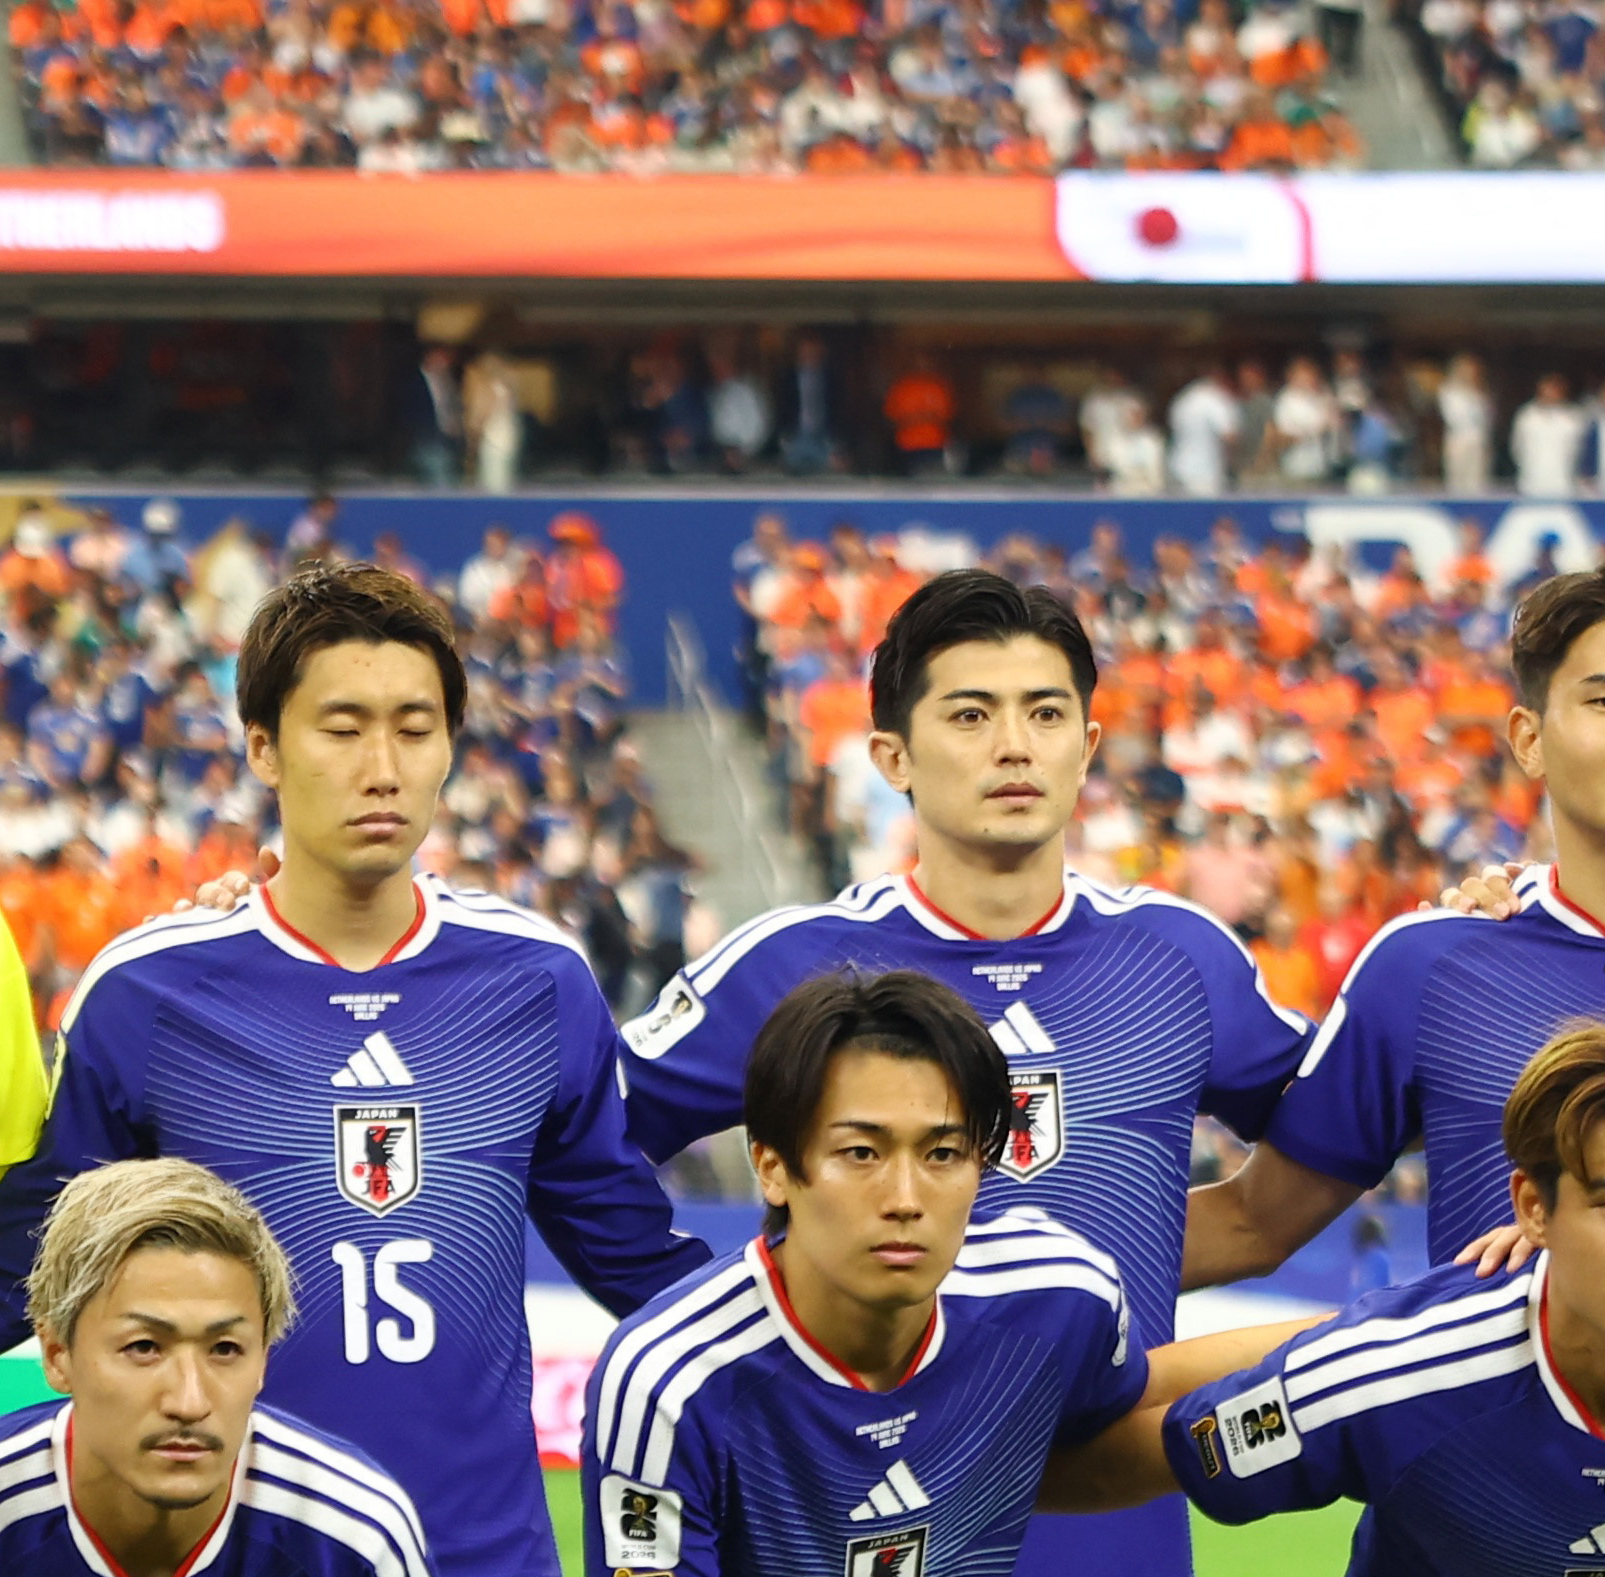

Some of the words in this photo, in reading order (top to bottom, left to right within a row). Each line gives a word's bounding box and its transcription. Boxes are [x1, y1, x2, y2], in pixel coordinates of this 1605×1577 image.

[1009, 1075, 1042, 1085] PAN
[357, 1109, 398, 1119] JAPAN
[361, 1179, 396, 1196] JFA
[332, 1240, 437, 1366] 15
[1224, 1417, 1240, 1456] 2026
[628, 1528, 648, 1538] FIFA
[868, 1533, 909, 1549] JAPAN
[621, 1550, 656, 1560] 2026
